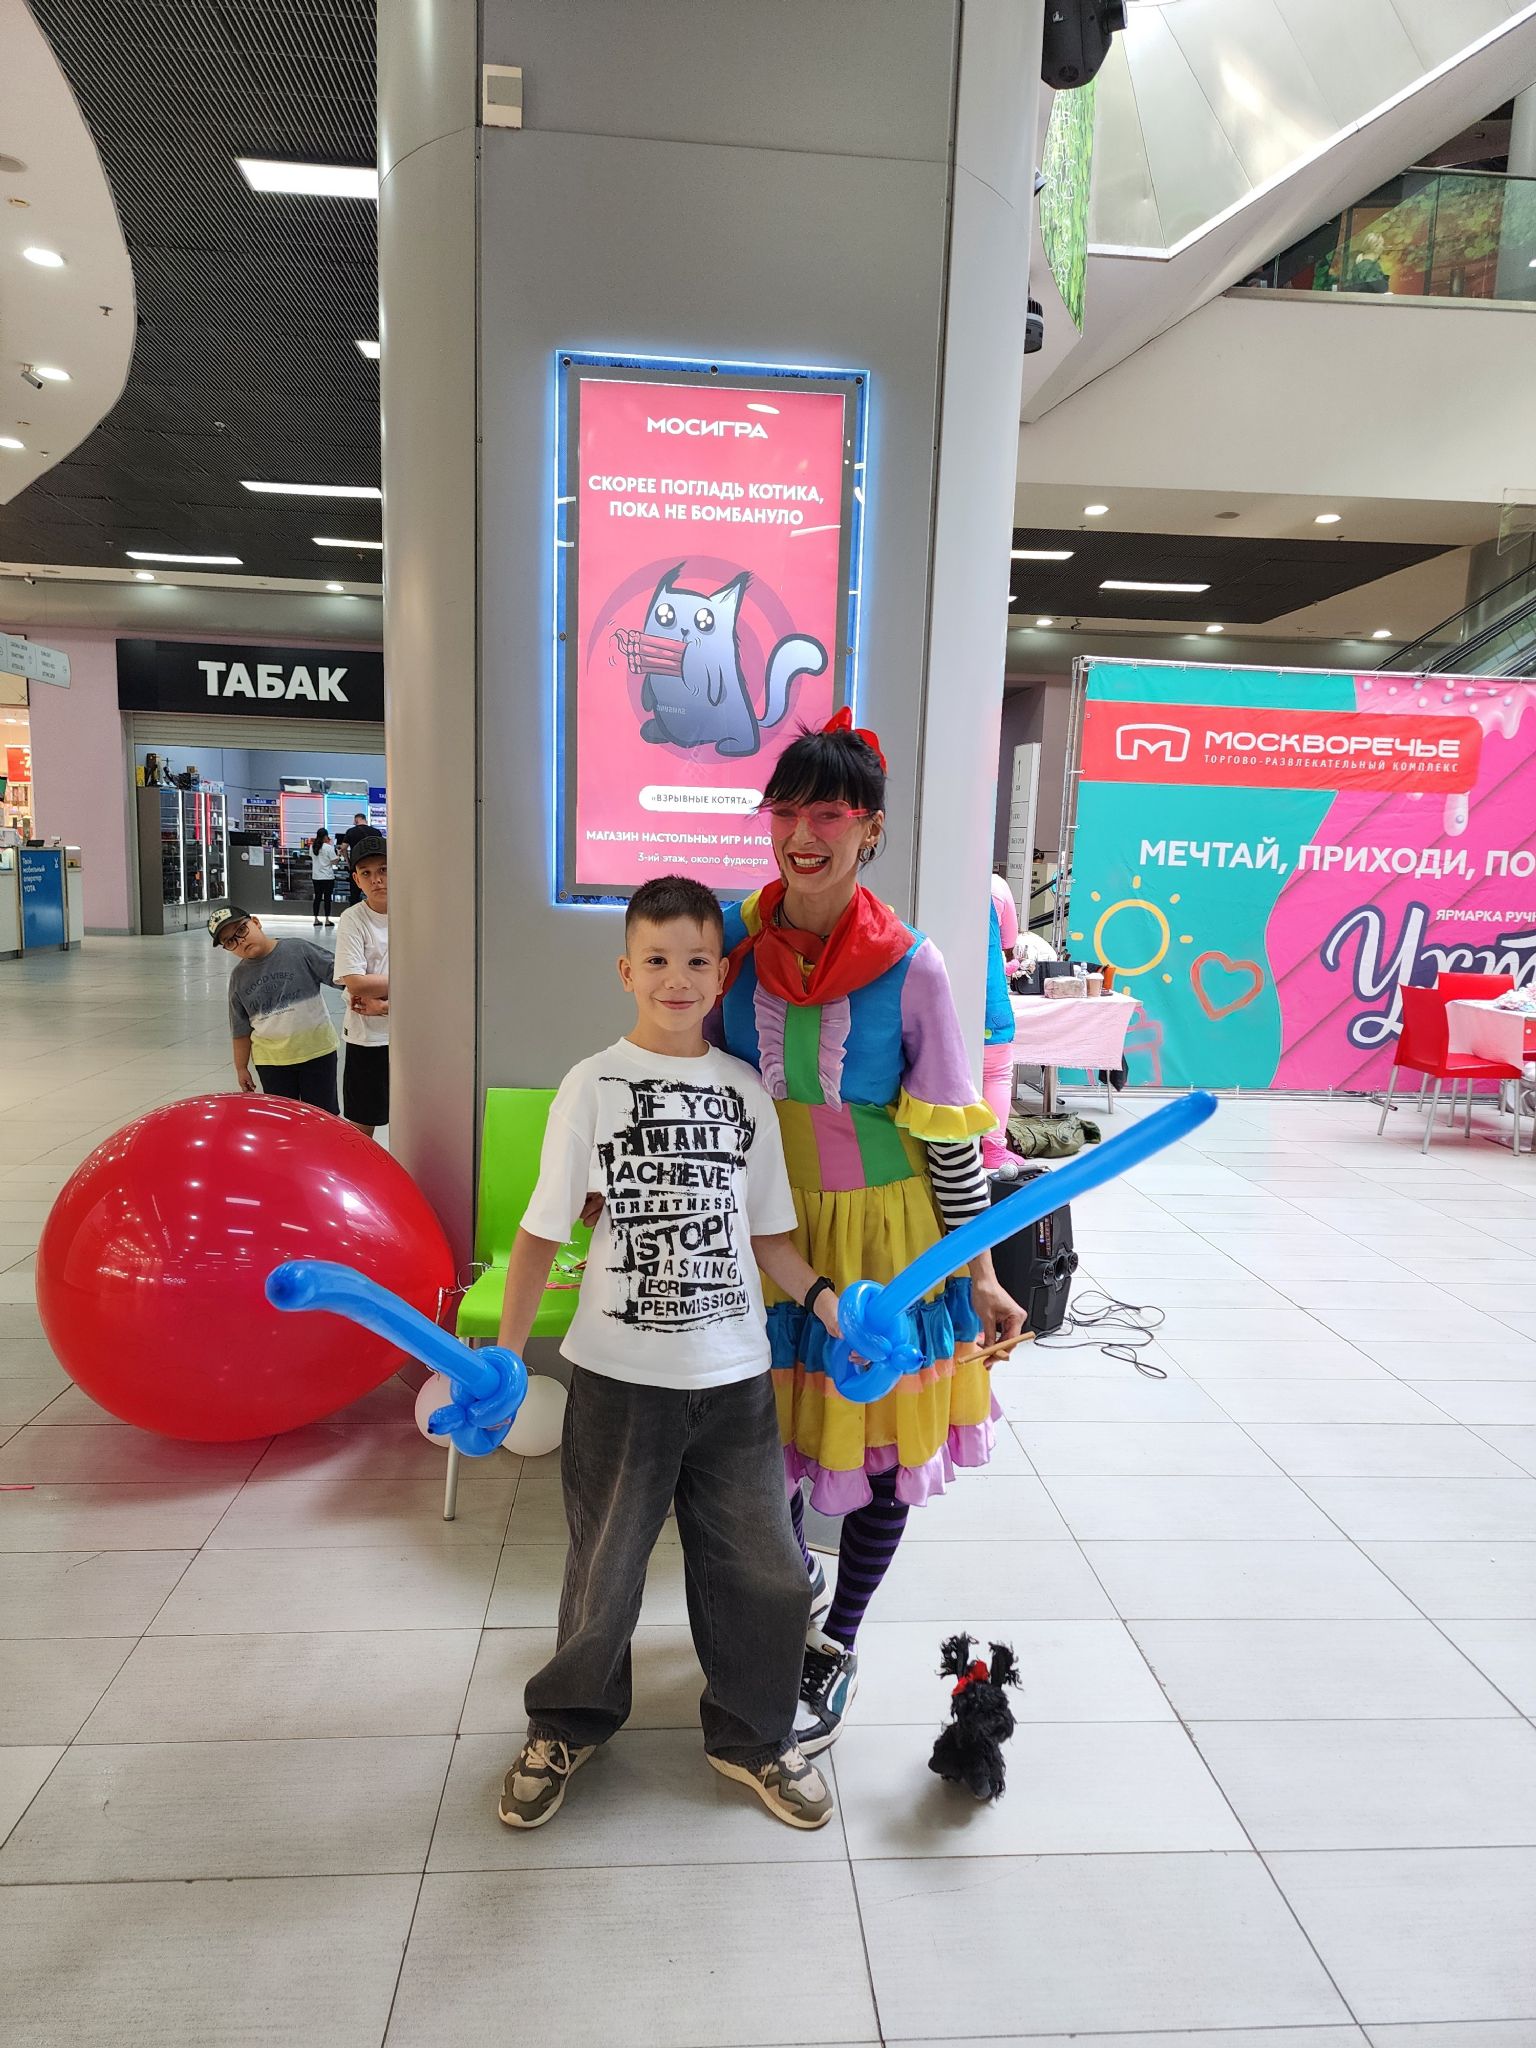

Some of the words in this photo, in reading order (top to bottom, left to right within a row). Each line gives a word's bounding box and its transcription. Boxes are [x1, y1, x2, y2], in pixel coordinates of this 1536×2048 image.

[646, 416, 769, 439] МОСИГРА
[588, 475, 657, 494] СКОРЕЕ
[660, 479, 745, 500] ПОГЛАДЬ
[748, 483, 824, 504] КОТИКА,
[609, 501, 660, 519] ПОКА
[664, 504, 687, 520] НЕ
[691, 505, 804, 525] БОМБАНУЛО
[197, 660, 350, 703] ТАБАК
[1204, 730, 1461, 759] МОСКВОРЕЧЬЕ
[1204, 754, 1386, 770] ТОРГОВО-РАЗВЛЕКАТЕЛЬНЫЙ
[1392, 761, 1459, 773] КОМПЛЕКС
[651, 794, 709, 804] «ВЗРЫВНЫЕ
[711, 795, 753, 805] КОТЯТА»
[586, 830, 639, 842] МАГАЗИН
[642, 833, 718, 845] НАСТОЛЬНЫХ
[720, 835, 741, 845] ИГР
[743, 836, 752, 845] И
[755, 836, 773, 847] ПО
[637, 851, 660, 864] 3-ий
[662, 854, 688, 865] этаж,
[690, 856, 720, 865] около
[722, 854, 768, 867] фудкорта
[1140, 836, 1288, 875] МЕЧТАЙ,
[1298, 845, 1476, 881] ПРИХОДИ,
[1436, 909, 1503, 922] ЯРМАРКА
[639, 1094, 665, 1119] IF
[681, 1094, 740, 1122] YOU
[645, 1127, 721, 1153] WANT
[616, 1161, 730, 1191] ACHIEVE
[615, 1196, 732, 1214] GREATNESS
[634, 1214, 723, 1261] STOP
[662, 1259, 738, 1280] ASKING
[648, 1279, 680, 1295] FOR
[640, 1291, 747, 1317] PERMISSION
